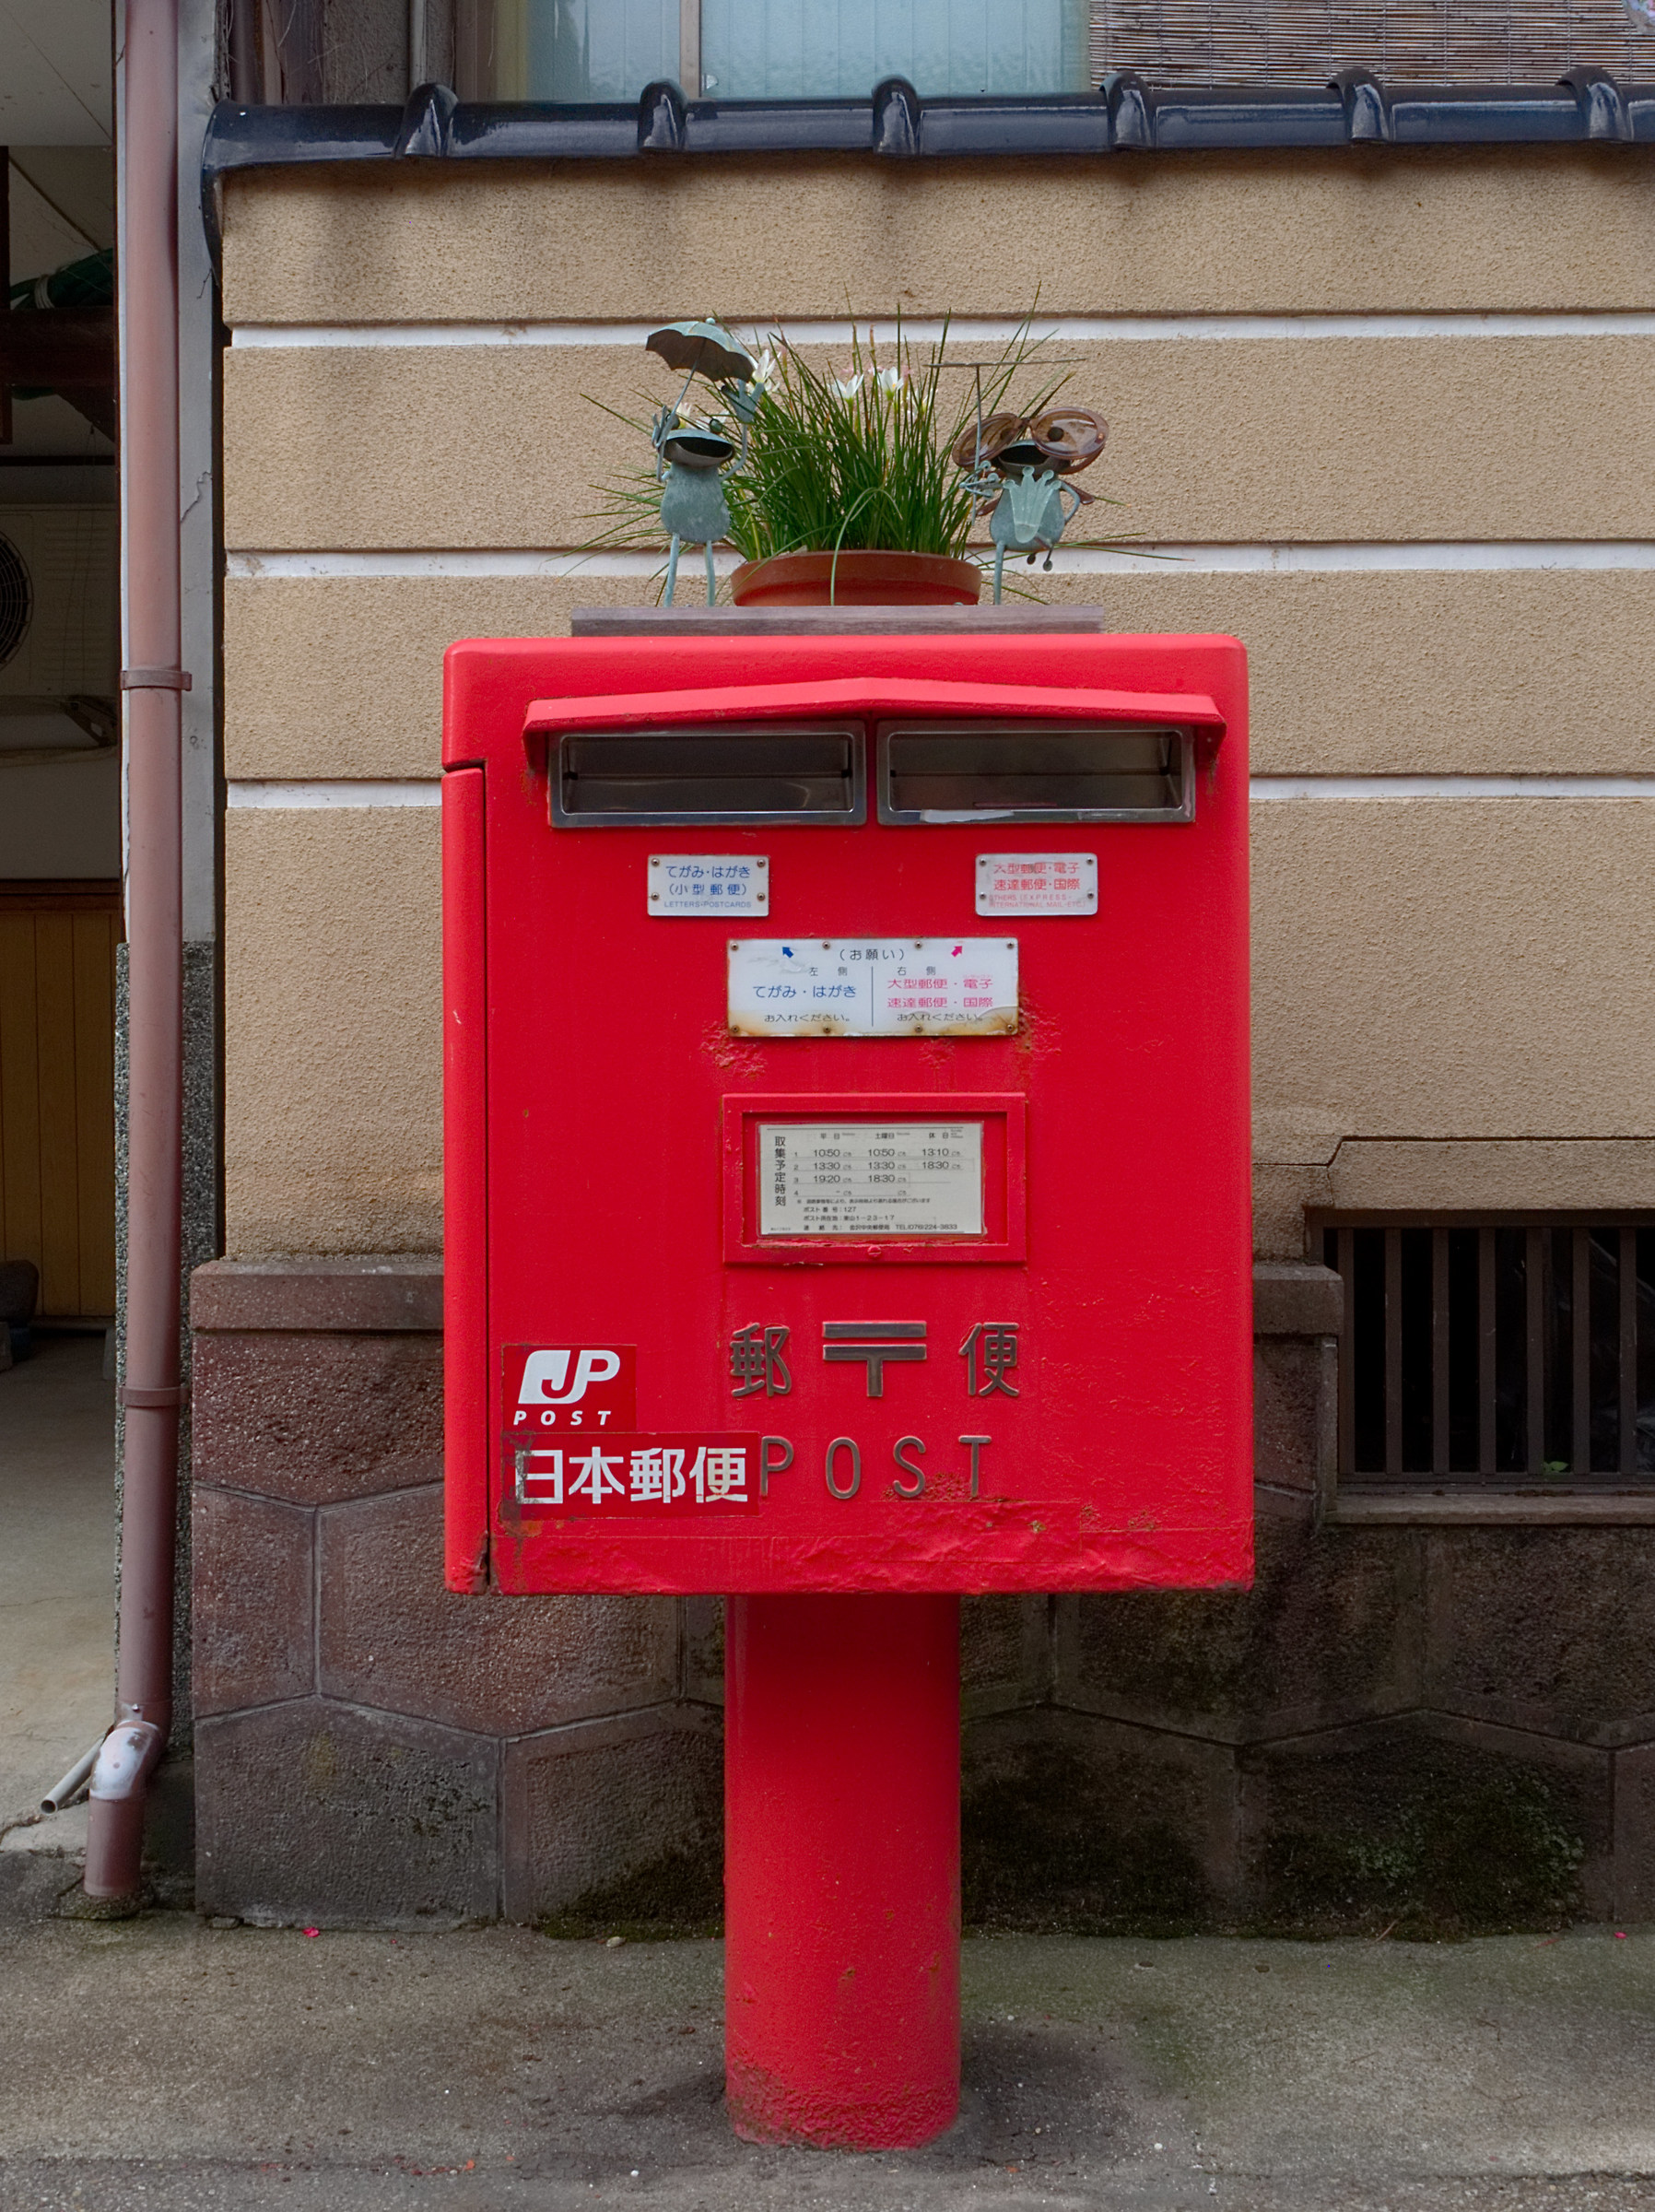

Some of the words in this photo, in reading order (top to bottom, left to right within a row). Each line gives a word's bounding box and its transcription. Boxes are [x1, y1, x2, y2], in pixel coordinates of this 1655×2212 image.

[665, 865, 751, 878] てがみ・はがき
[993, 862, 1081, 875] 大型郵便・電子
[669, 883, 747, 896] （小型郵便）
[993, 878, 1081, 891] 速達郵便・国際
[839, 948, 905, 961] （お願い）
[886, 978, 993, 990] 大型郵便・電子
[752, 984, 857, 998] てがみ・はがき
[886, 997, 993, 1008] 速達郵便・国際
[814, 1148, 840, 1158] 10:50
[868, 1148, 895, 1157] 10:50
[921, 1147, 949, 1157] 13:10
[774, 1135, 786, 1206] 取集予定時刻
[814, 1161, 840, 1171] 13:30
[868, 1161, 895, 1171] 13:30
[921, 1161, 949, 1170] 18:30
[814, 1174, 840, 1183] 19:20
[868, 1174, 895, 1183] 18:30
[518, 1350, 620, 1405] JP
[513, 1410, 611, 1426] POST
[760, 1435, 992, 1500] POST
[514, 1446, 748, 1505] 日本郵便
